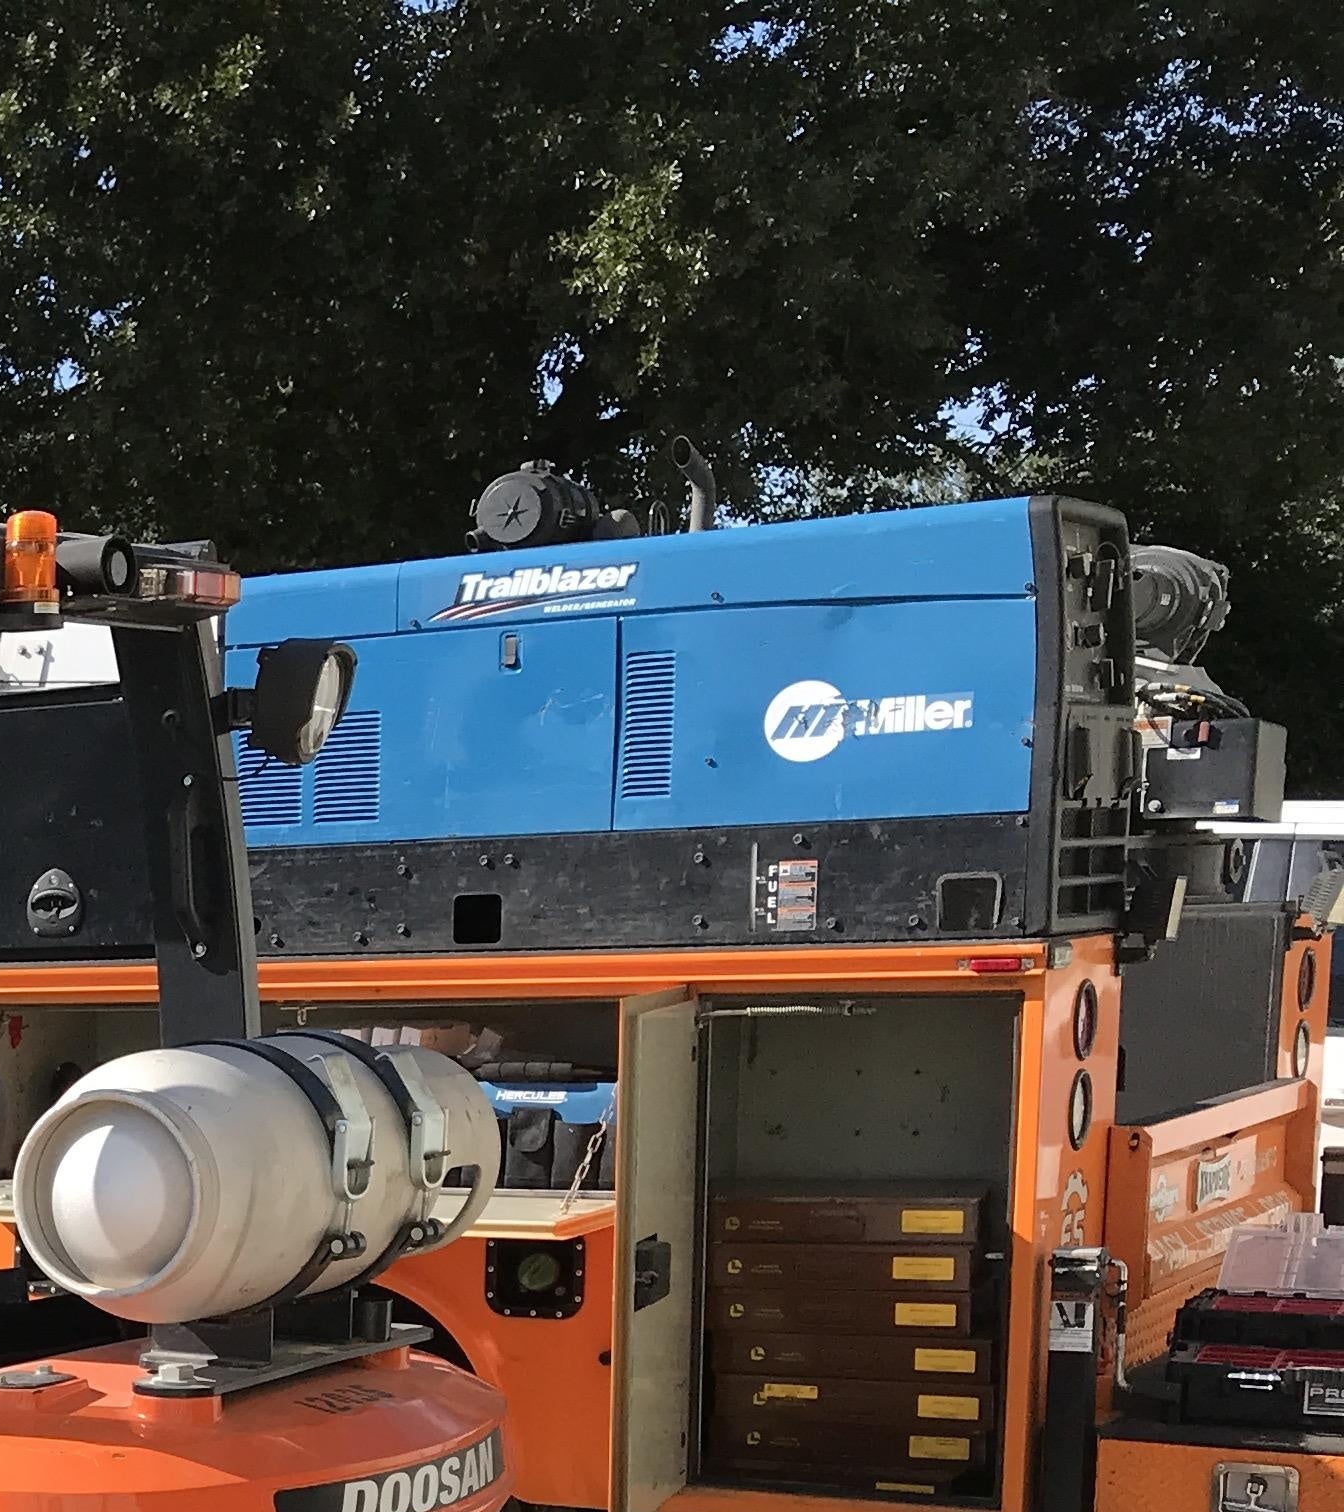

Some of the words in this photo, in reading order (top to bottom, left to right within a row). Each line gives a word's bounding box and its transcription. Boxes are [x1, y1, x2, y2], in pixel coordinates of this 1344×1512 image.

[461, 563, 638, 601] Trailblazer
[543, 598, 637, 613] WELDER/GENERATOR
[495, 1090, 568, 1101] HERCULES
